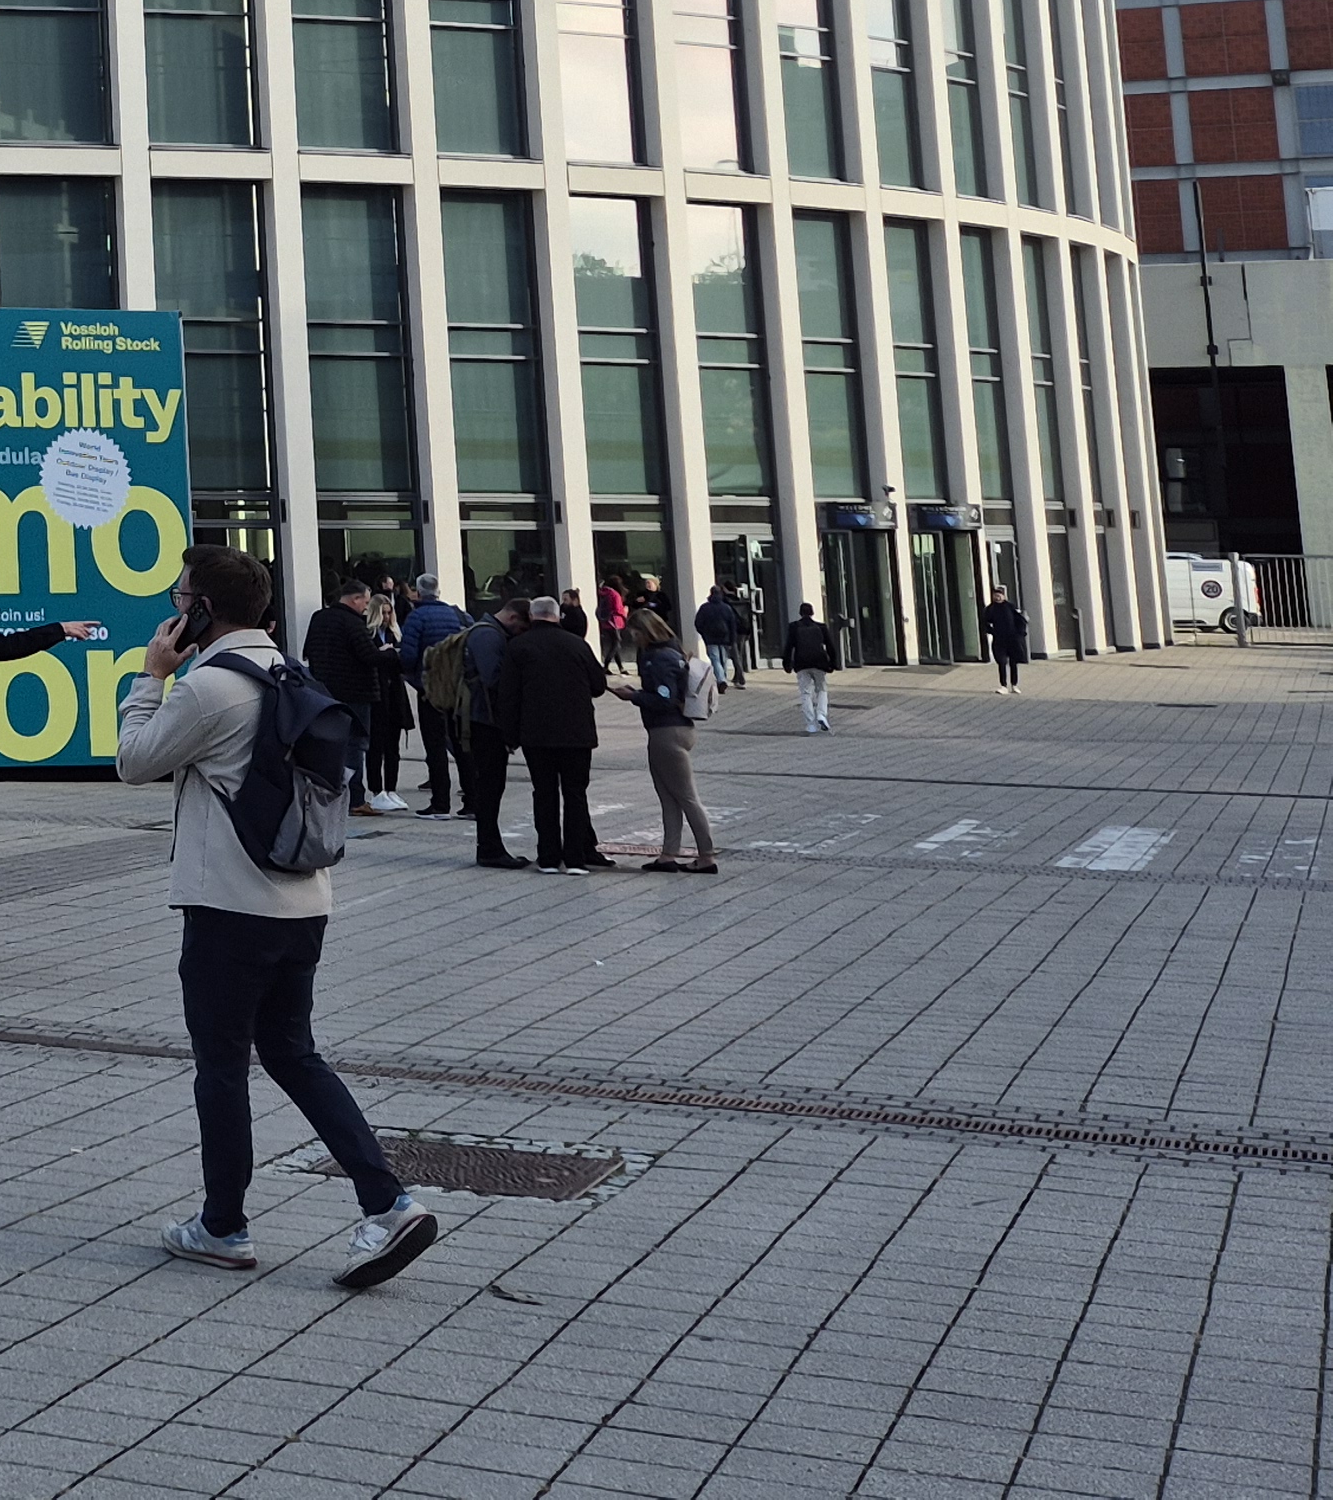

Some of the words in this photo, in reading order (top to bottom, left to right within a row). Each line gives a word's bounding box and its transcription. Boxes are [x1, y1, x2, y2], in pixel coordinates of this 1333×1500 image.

[60, 321, 119, 336] Vossloh
[61, 336, 113, 354] Rolling
[115, 336, 161, 351] Stock
[1206, 584, 1219, 594] 20
[25, 608, 45, 623] us!
